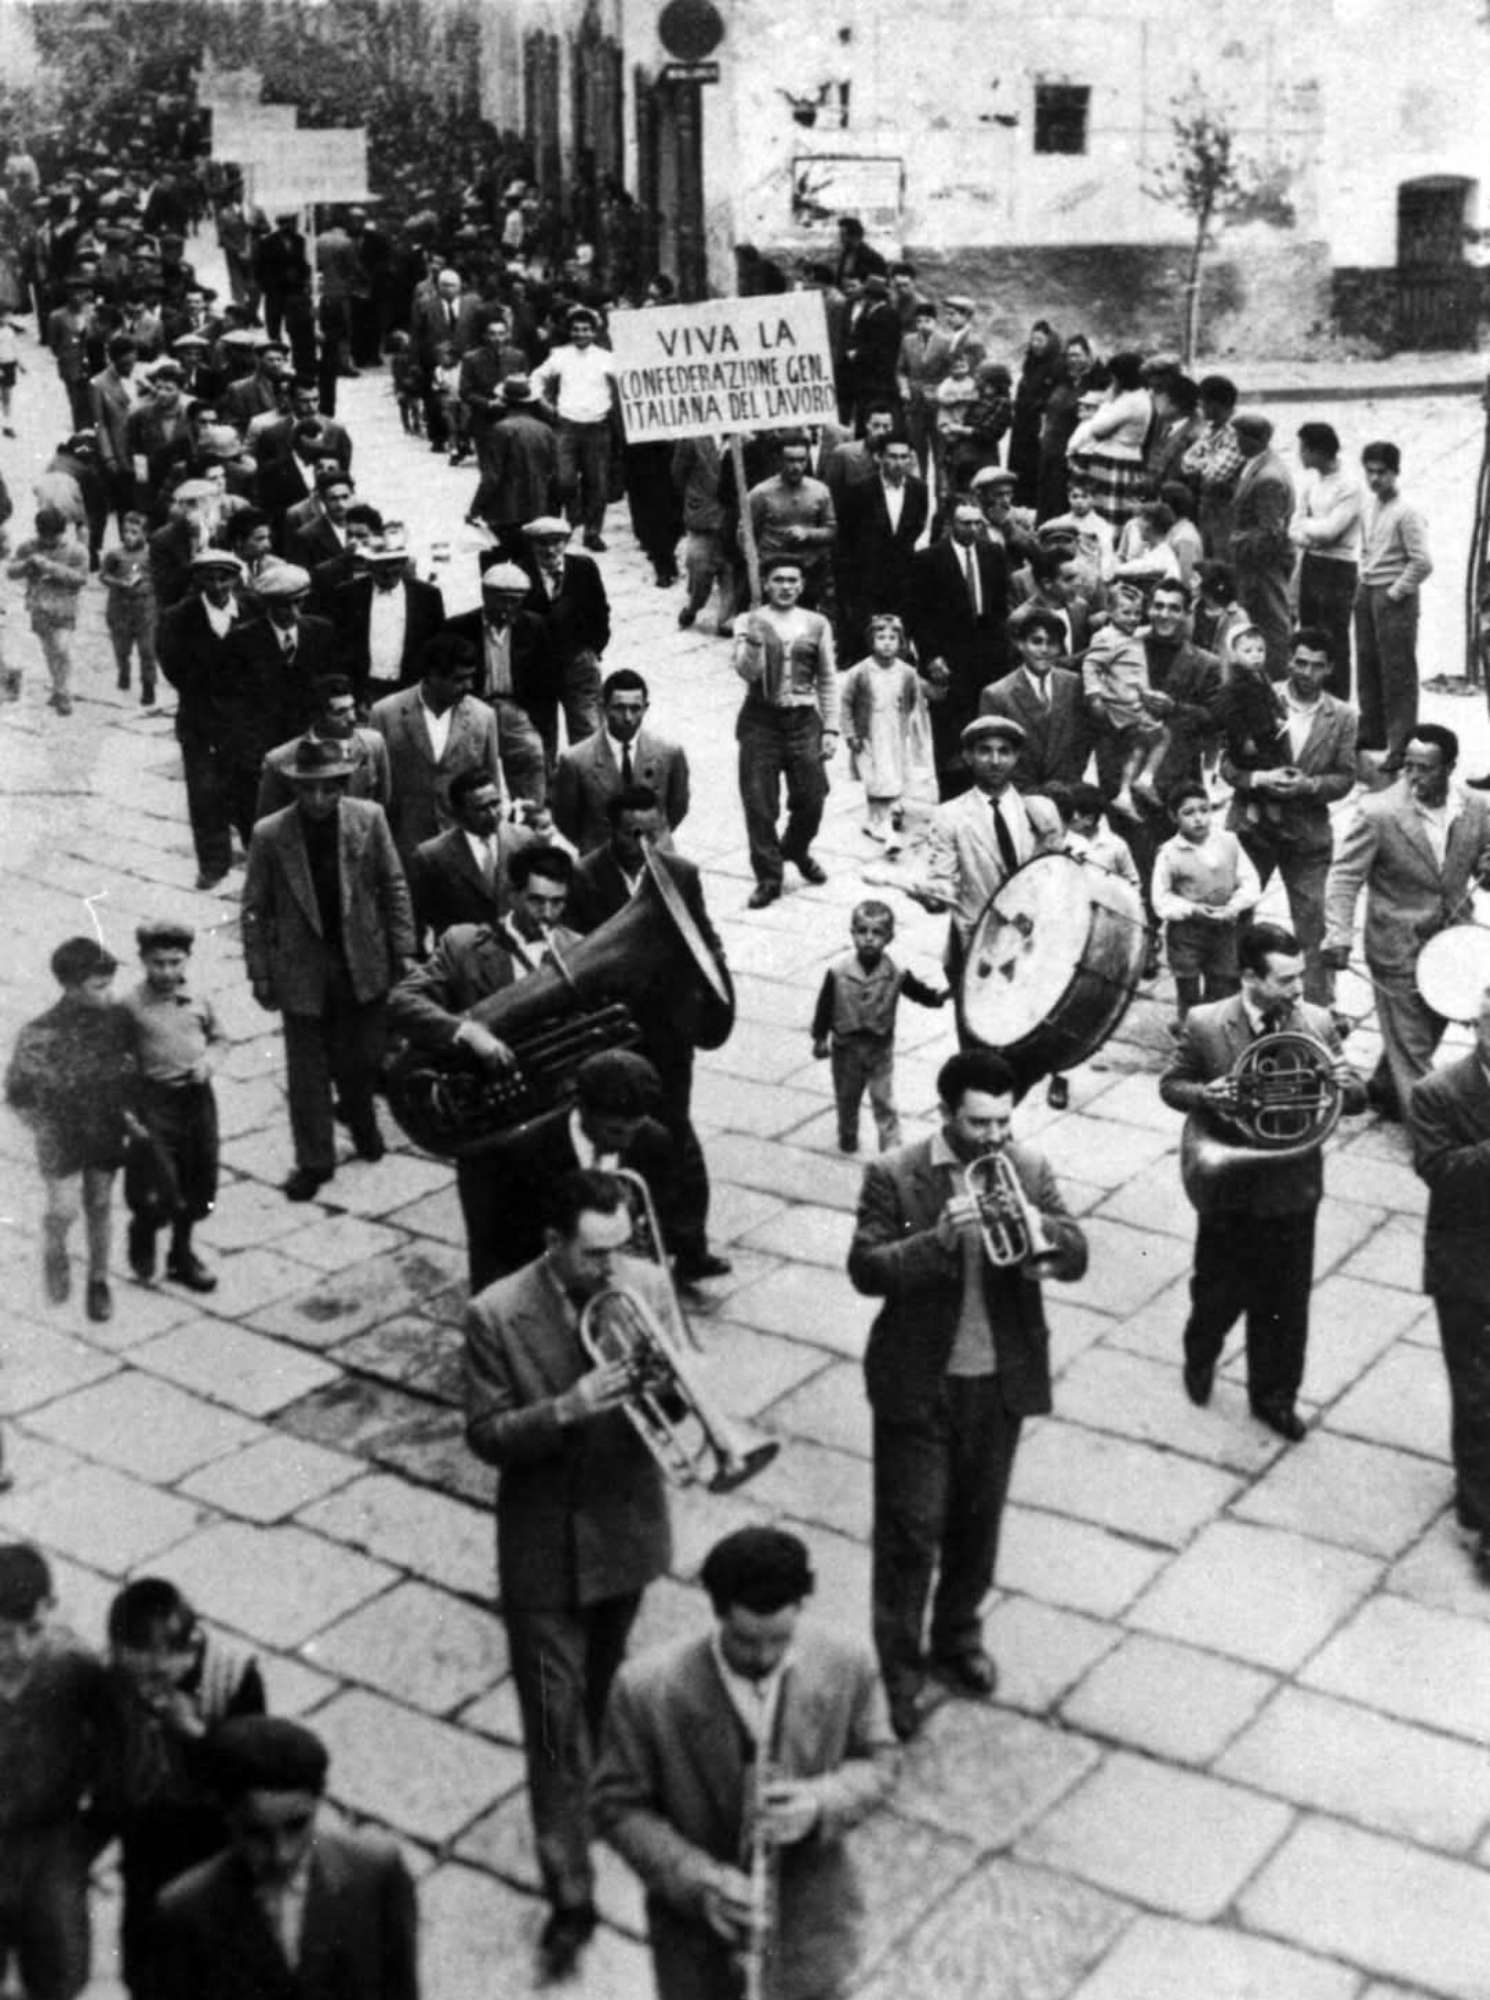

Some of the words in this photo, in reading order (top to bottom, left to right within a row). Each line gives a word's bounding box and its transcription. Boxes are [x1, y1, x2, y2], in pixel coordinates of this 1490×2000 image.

[656, 324, 740, 357] VIVA
[759, 319, 796, 349] LA
[619, 357, 780, 400] CONFEDERAZIONE
[626, 394, 723, 430] ITALIANA
[728, 389, 760, 421] DEL
[765, 384, 836, 419] LAVORO
